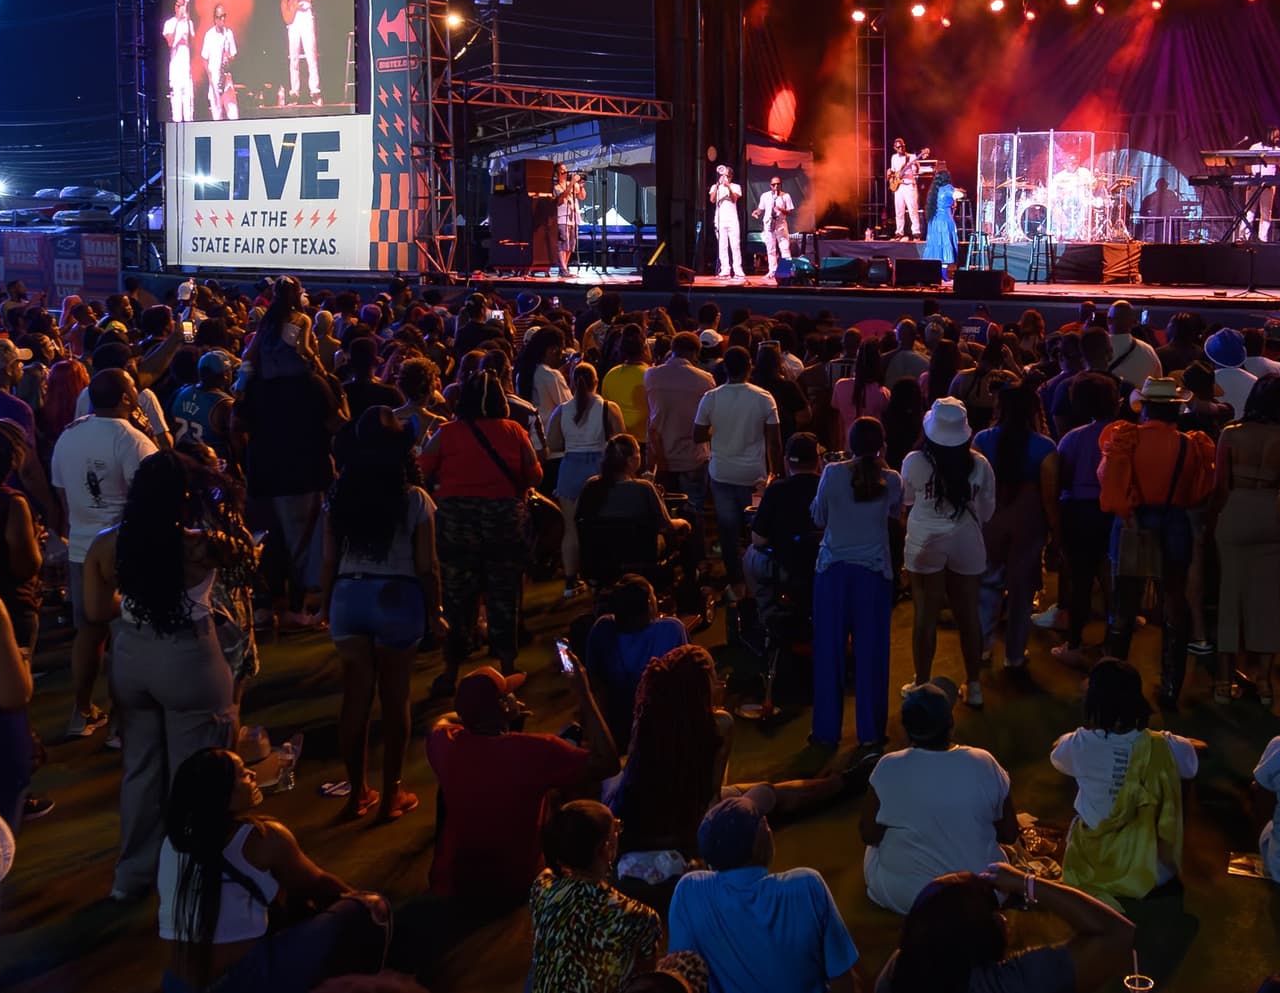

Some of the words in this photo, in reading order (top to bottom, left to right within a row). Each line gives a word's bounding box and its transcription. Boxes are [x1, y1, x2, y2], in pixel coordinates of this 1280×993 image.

[194, 130, 341, 201] LIVE
[240, 211, 257, 227] AT
[261, 211, 288, 227] THE
[191, 237, 230, 254] STATE
[234, 237, 265, 254] FAIR
[269, 238, 288, 255] OF
